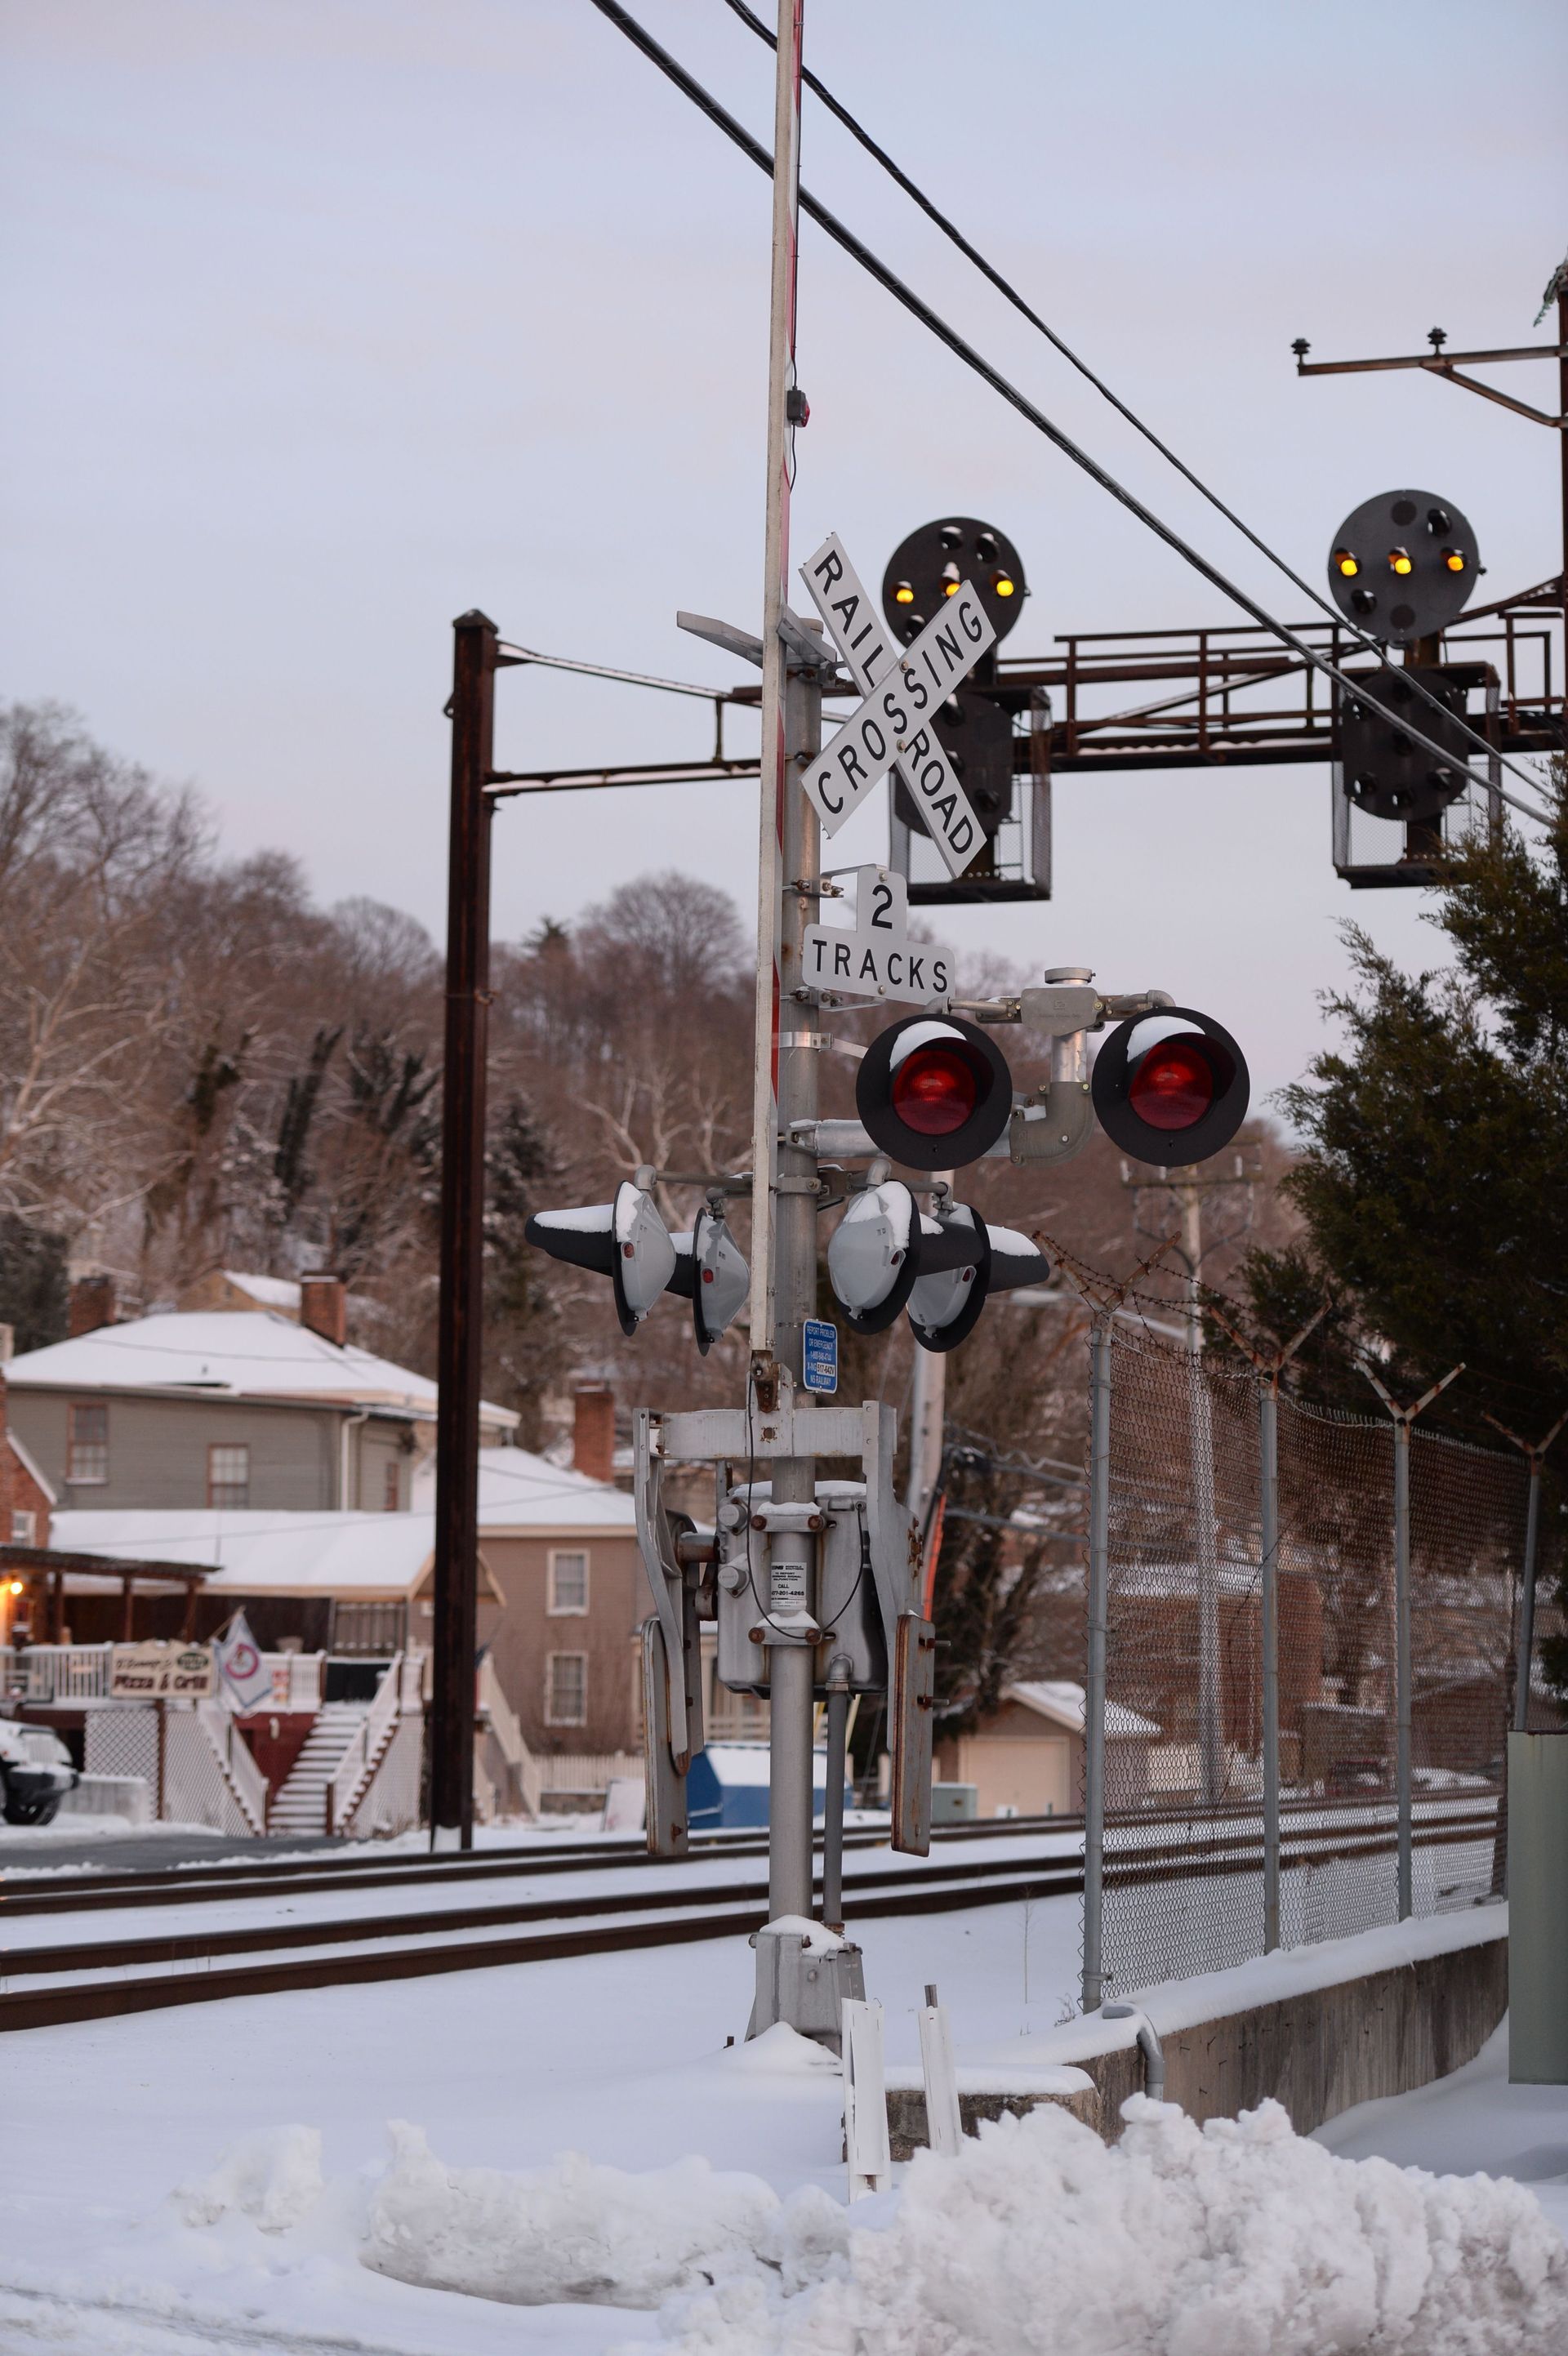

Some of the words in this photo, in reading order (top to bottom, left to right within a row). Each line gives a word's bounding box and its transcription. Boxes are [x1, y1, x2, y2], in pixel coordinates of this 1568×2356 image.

[814, 550, 884, 688] RAIL
[818, 602, 982, 814] CROSSING
[904, 728, 973, 854] ROAD
[871, 884, 893, 929] 2
[812, 939, 948, 993] TRACKS
[807, 1325, 819, 1335] REPORT
[820, 1328, 835, 1338] PROBLEM
[808, 1338, 814, 1347] OR
[814, 1339, 832, 1349] EMERGENCY
[816, 1375, 831, 1385] RAILWAY
[114, 1675, 154, 1690] Pizza
[175, 1675, 208, 1690] Grill
